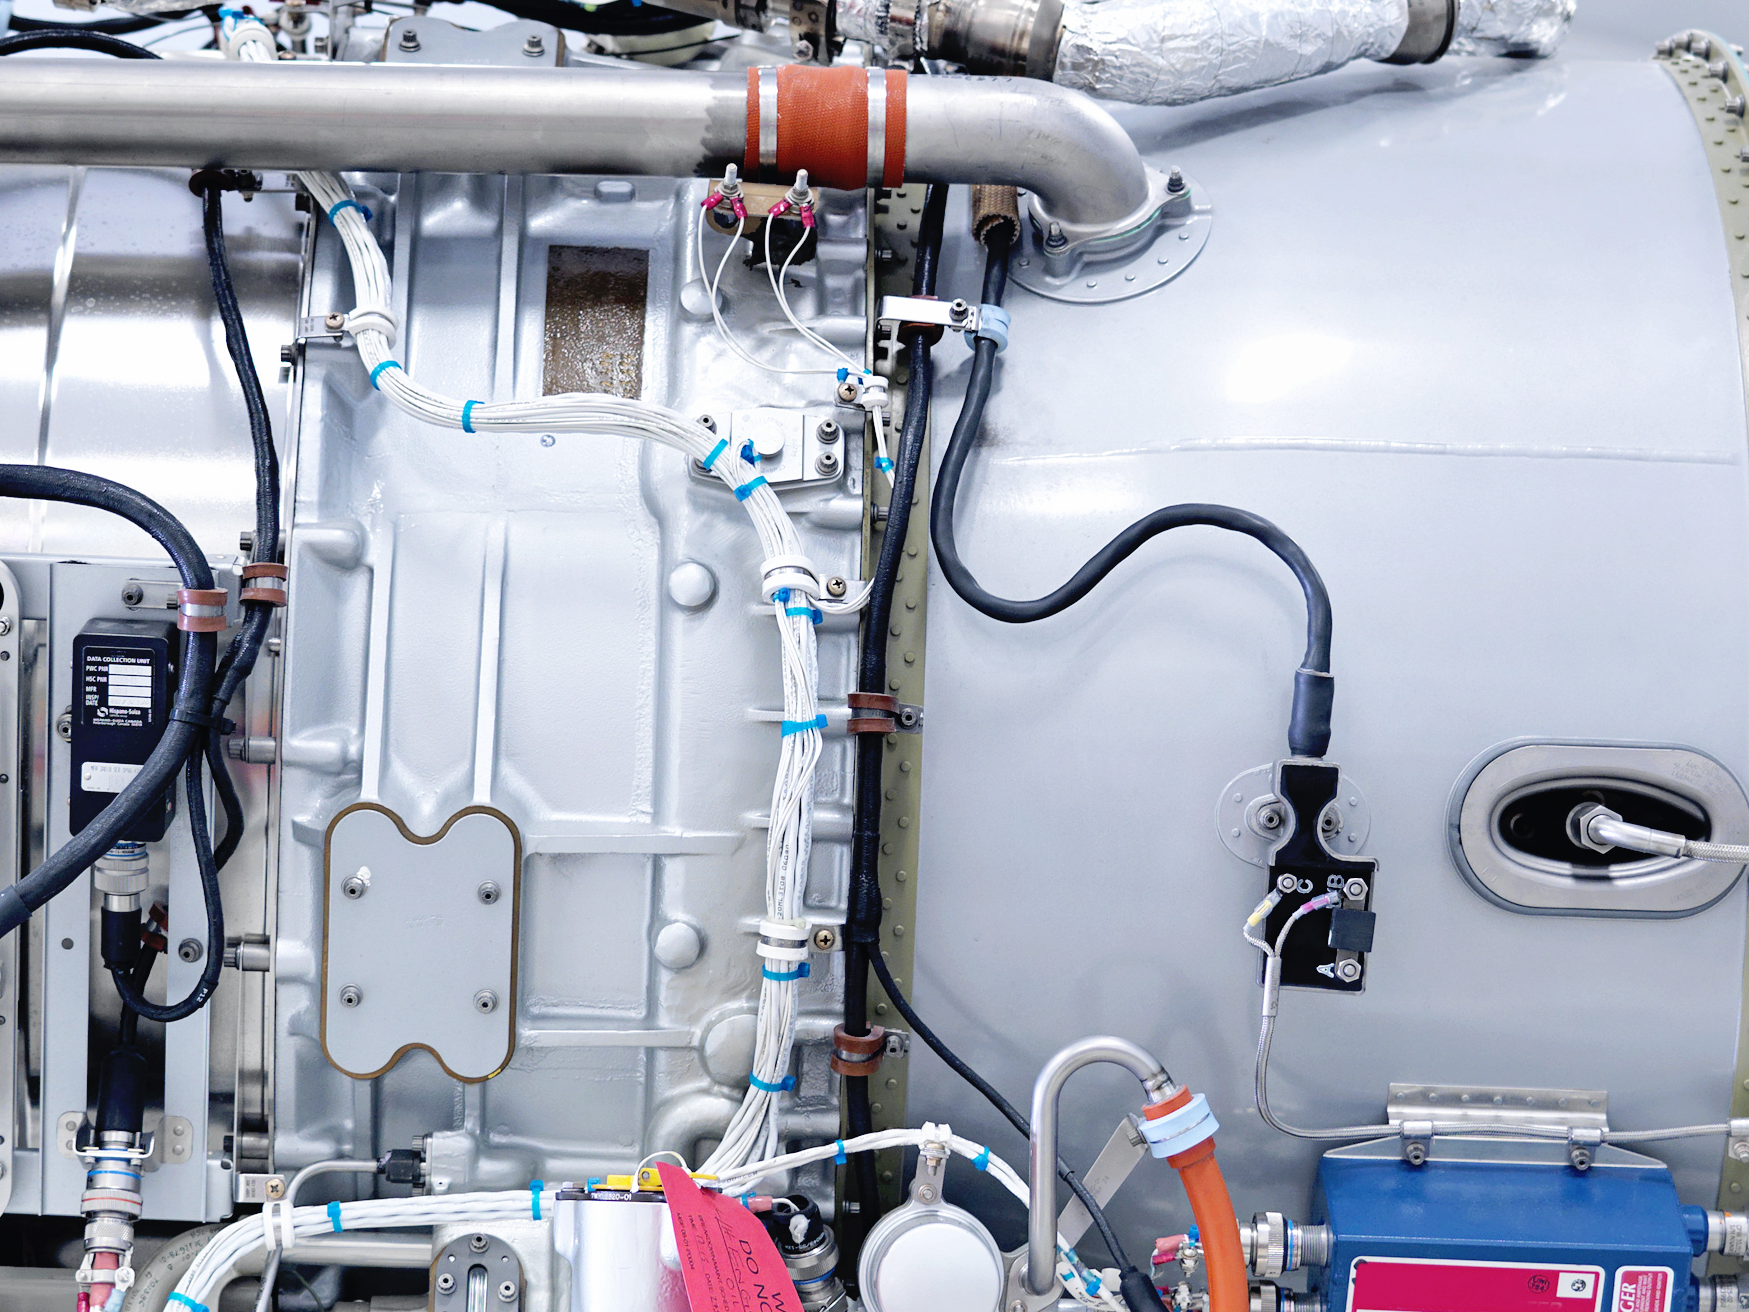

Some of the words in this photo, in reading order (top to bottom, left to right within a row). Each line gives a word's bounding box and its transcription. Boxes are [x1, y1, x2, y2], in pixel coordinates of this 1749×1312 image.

[1297, 879, 1313, 894] C
[1316, 962, 1335, 979] A
[739, 1240, 759, 1274] DO
[725, 1277, 739, 1307] OIL
